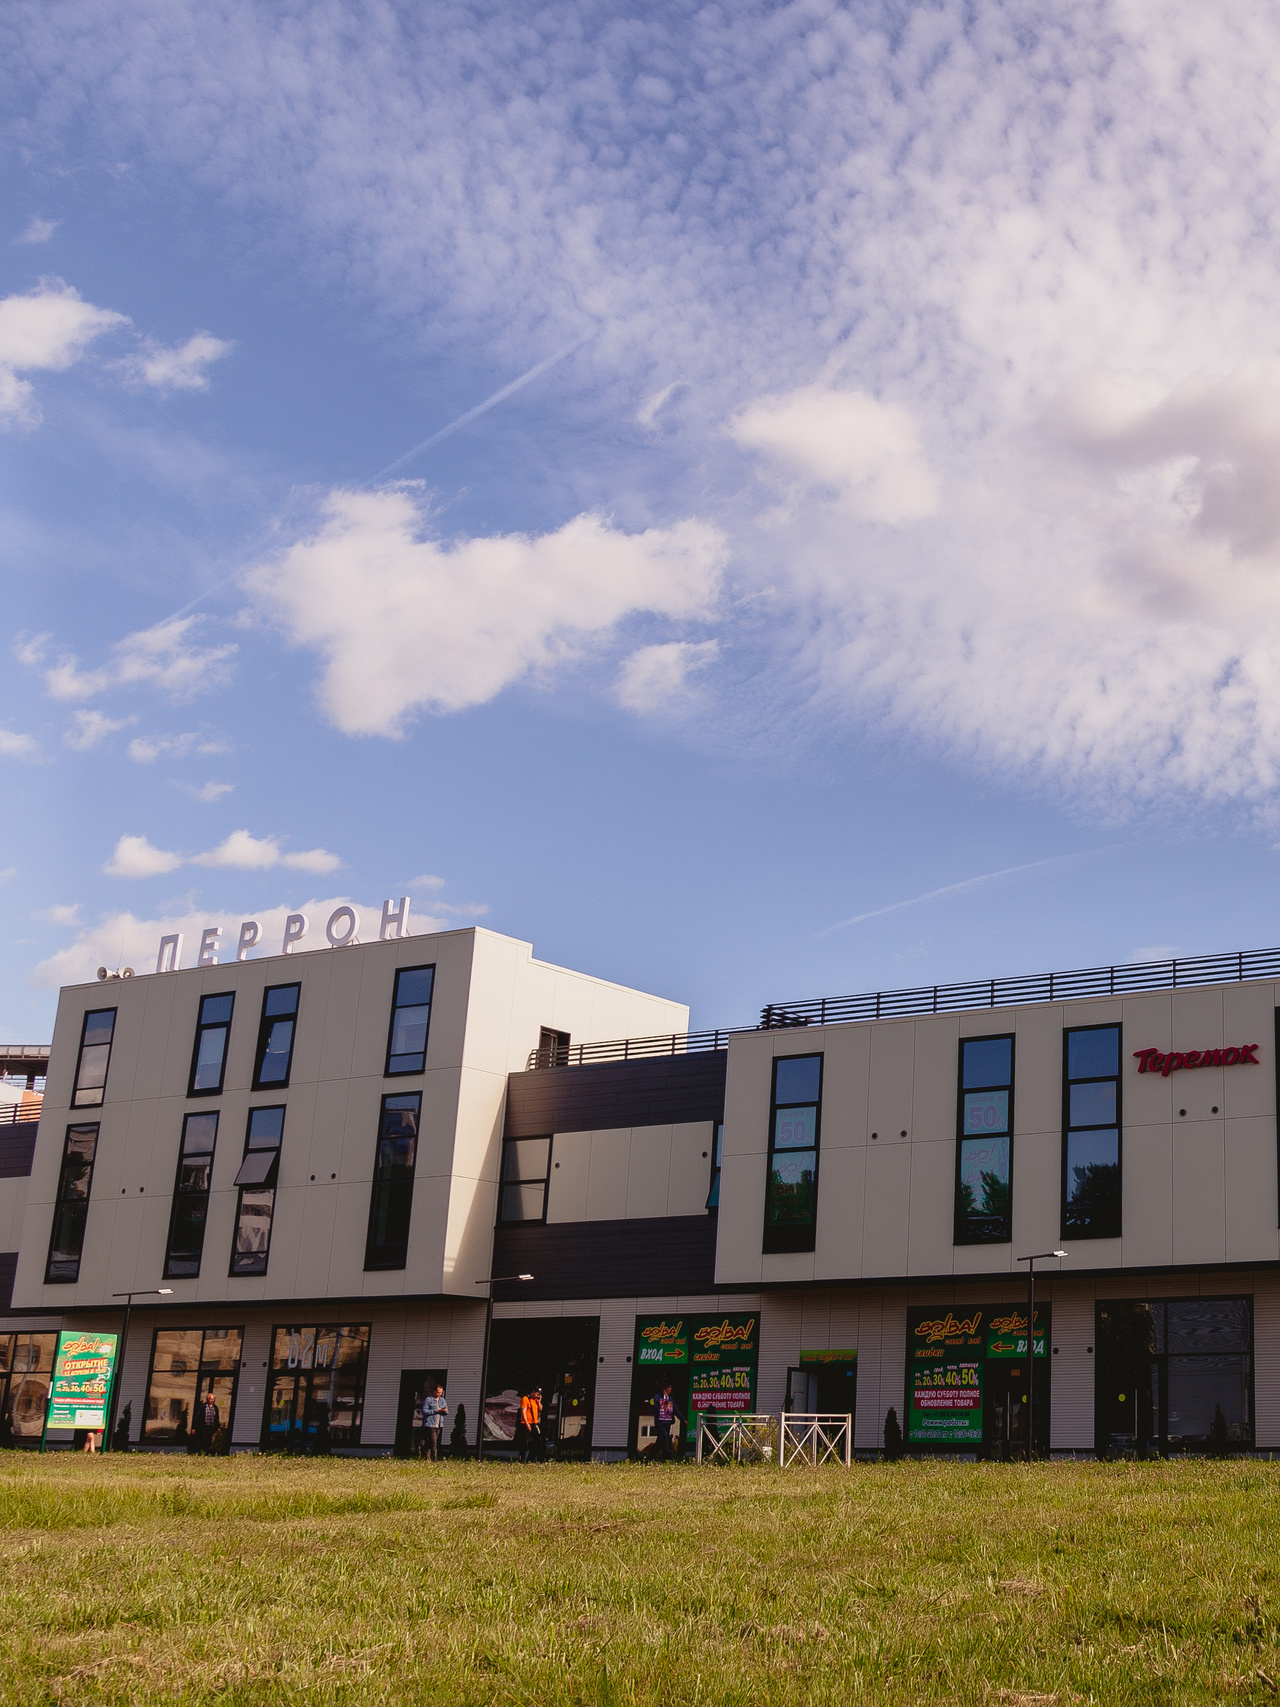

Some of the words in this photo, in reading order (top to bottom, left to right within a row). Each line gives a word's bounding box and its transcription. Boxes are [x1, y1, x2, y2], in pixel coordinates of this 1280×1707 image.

[156, 896, 411, 973] ПЕРРОН
[1132, 1043, 1260, 1077] Теремок
[968, 1105, 1007, 1130] 50%
[640, 1348, 663, 1361] ВХОД
[915, 1347, 945, 1357] скидки
[65, 1359, 108, 1370] ОТКРЫТИЕ
[720, 1375, 734, 1388] 40%
[734, 1372, 750, 1388] 50%
[922, 1376, 933, 1386] 20%
[933, 1374, 945, 1386] 30%
[945, 1371, 961, 1386] 40%
[961, 1369, 979, 1386] 50%
[914, 1391, 936, 1399] КАЖДУЮ
[959, 1390, 980, 1398] ПОЛНОЕ
[920, 1399, 953, 1407] ОБНОВЛЕНИЕ
[954, 1399, 973, 1407] ТОВАРА
